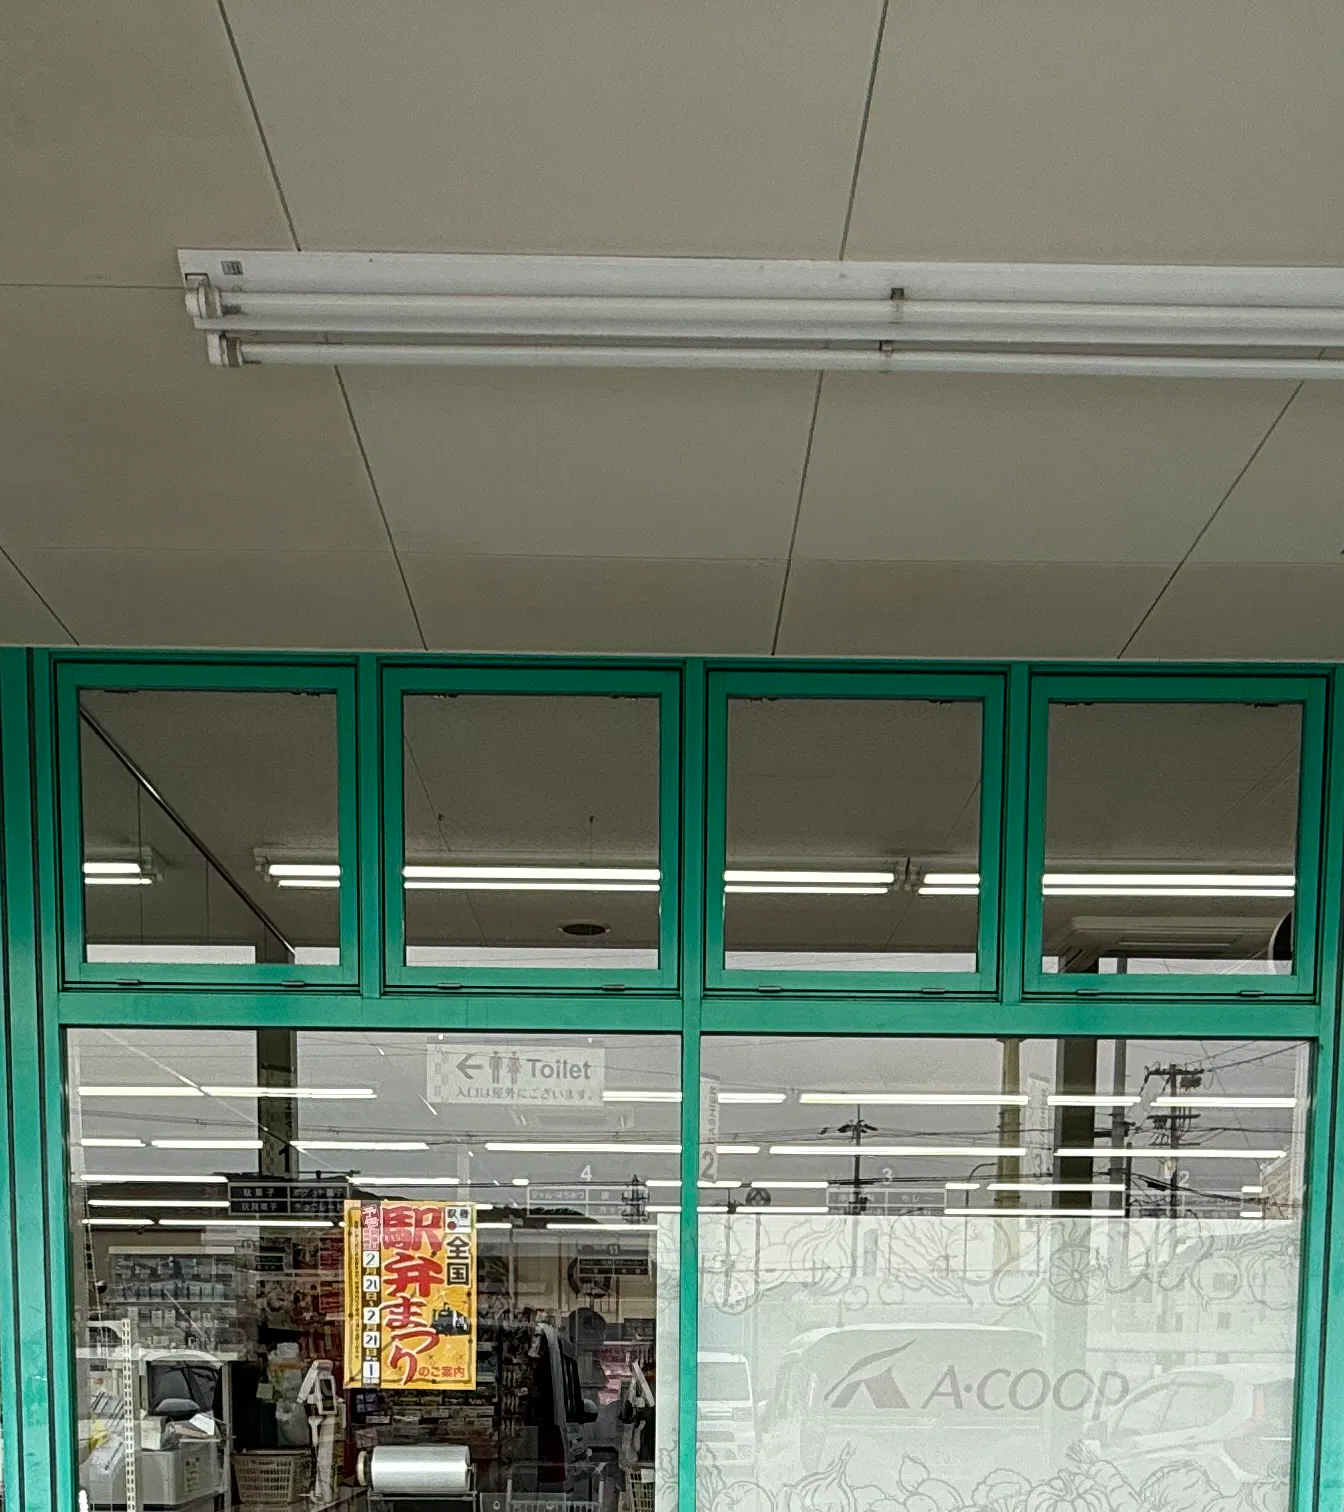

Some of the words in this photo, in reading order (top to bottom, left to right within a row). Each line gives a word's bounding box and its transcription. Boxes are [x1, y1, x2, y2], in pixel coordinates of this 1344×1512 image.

[526, 1058, 591, 1080] Toilet
[278, 1144, 290, 1173] 1
[700, 1150, 715, 1180] 2
[580, 1164, 593, 1182] 4
[445, 1235, 471, 1287] 全国
[417, 1365, 465, 1379] のご案内
